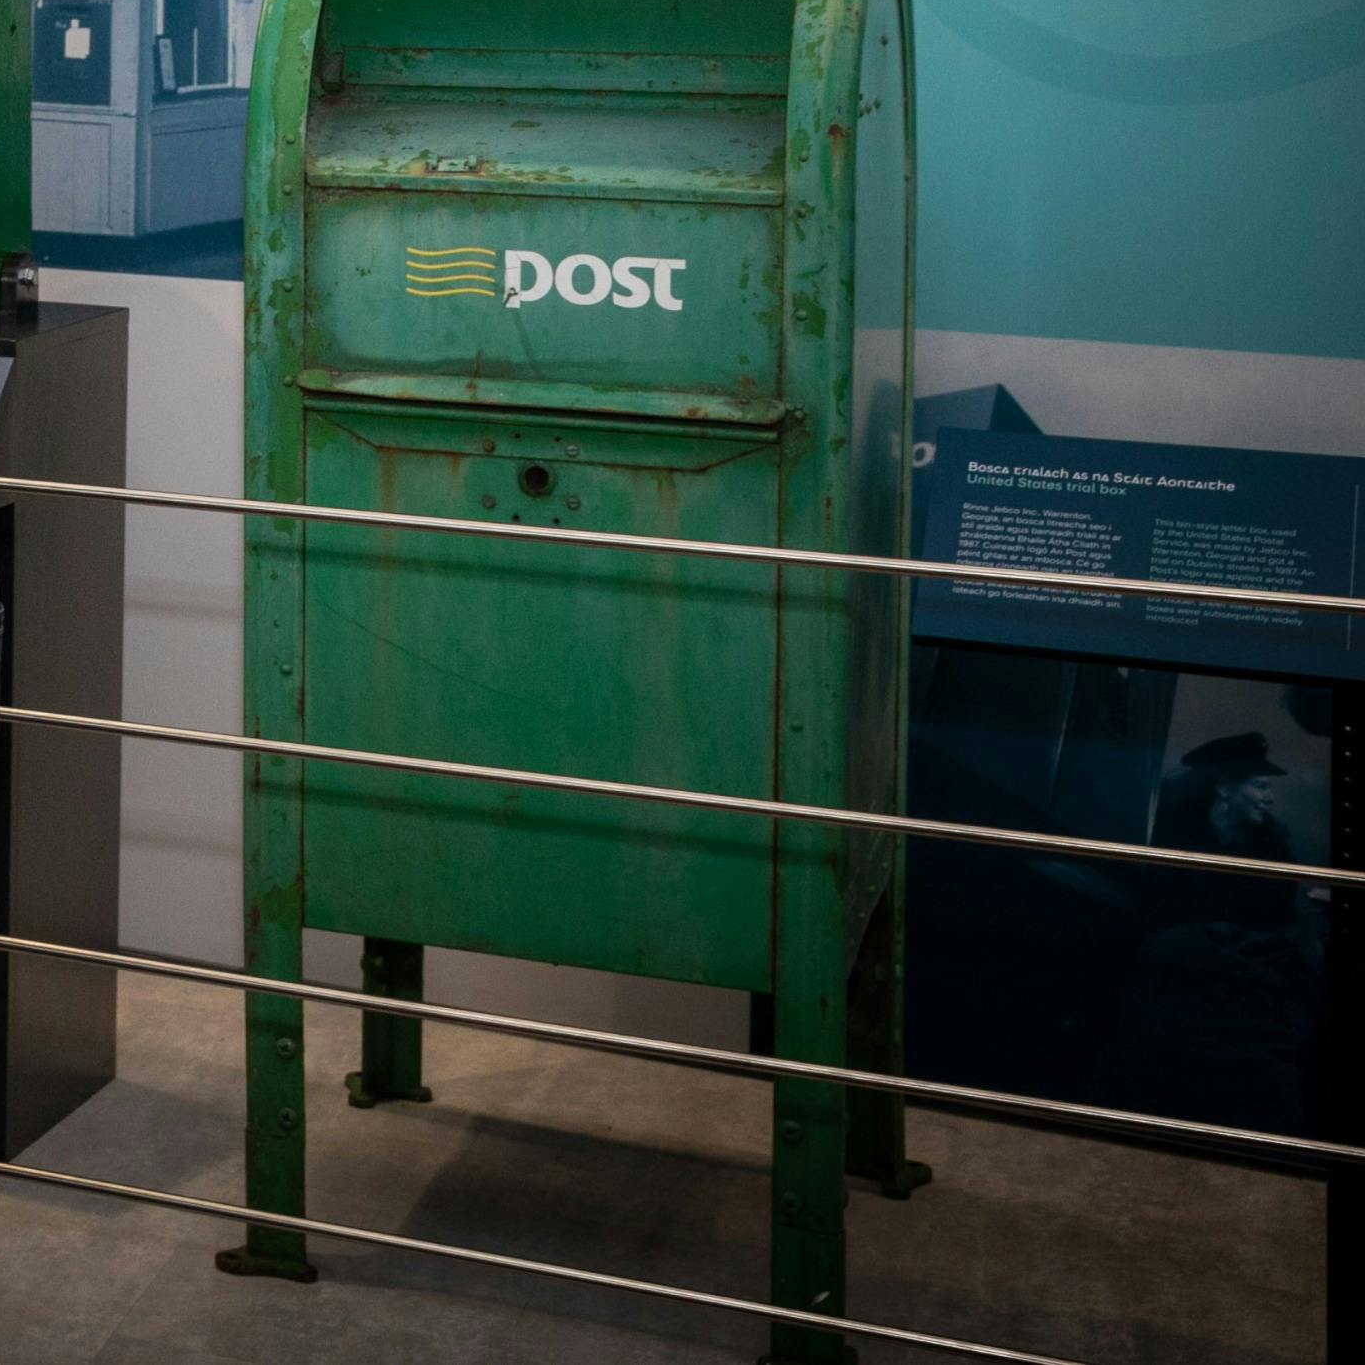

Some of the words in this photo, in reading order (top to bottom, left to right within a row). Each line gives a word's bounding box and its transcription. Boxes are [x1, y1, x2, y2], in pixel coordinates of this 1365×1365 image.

[966, 473, 1013, 487] United
[1017, 476, 1062, 490] States
[1066, 479, 1096, 493] trial
[1100, 481, 1127, 495] box
[968, 460, 1009, 474] Bosca
[1013, 466, 1069, 479] trialach
[1072, 471, 1089, 481] as
[1092, 473, 1110, 481] na
[1157, 475, 1236, 491] Aontaithe
